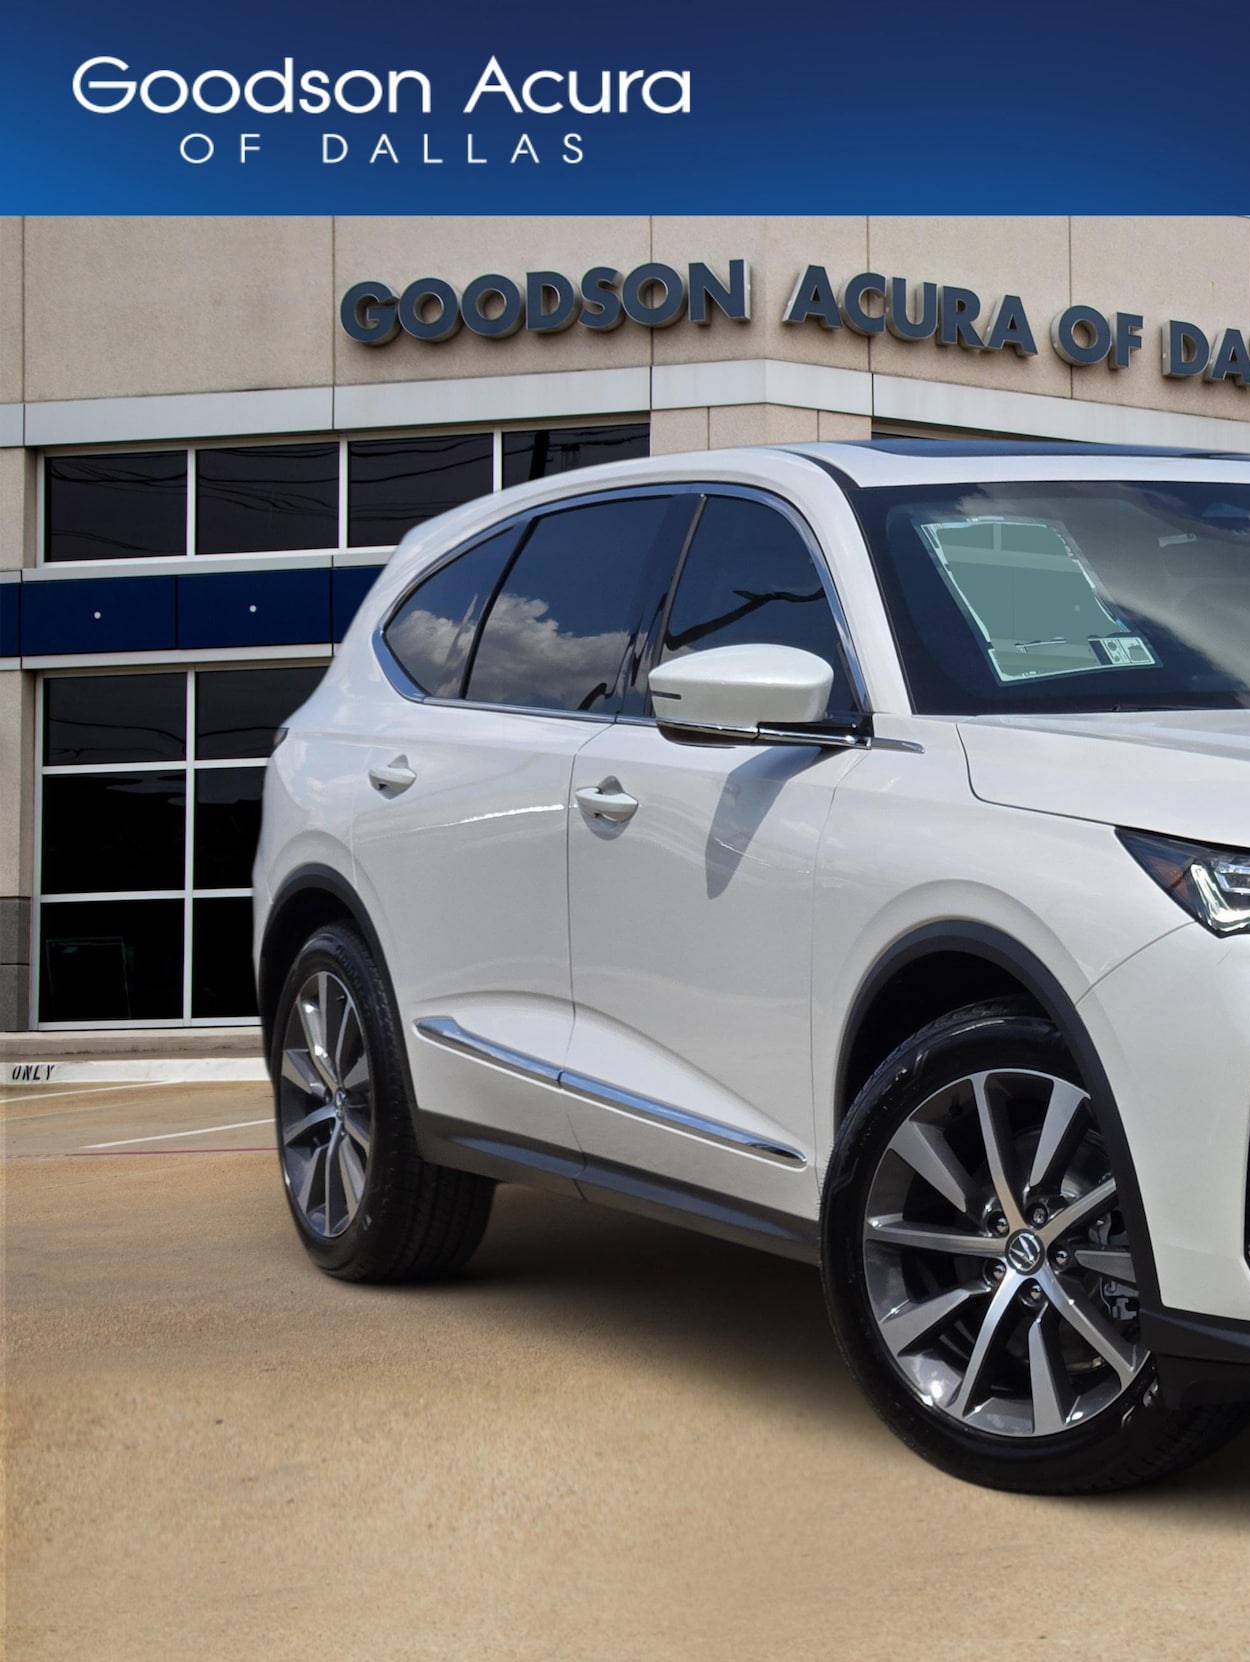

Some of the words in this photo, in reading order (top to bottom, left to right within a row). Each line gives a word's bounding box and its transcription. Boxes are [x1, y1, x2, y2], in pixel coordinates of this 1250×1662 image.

[340, 258, 752, 346] GOODSON
[782, 264, 1038, 357] ACURA
[1050, 304, 1143, 369] OF
[12, 1064, 55, 1081] ONLY
